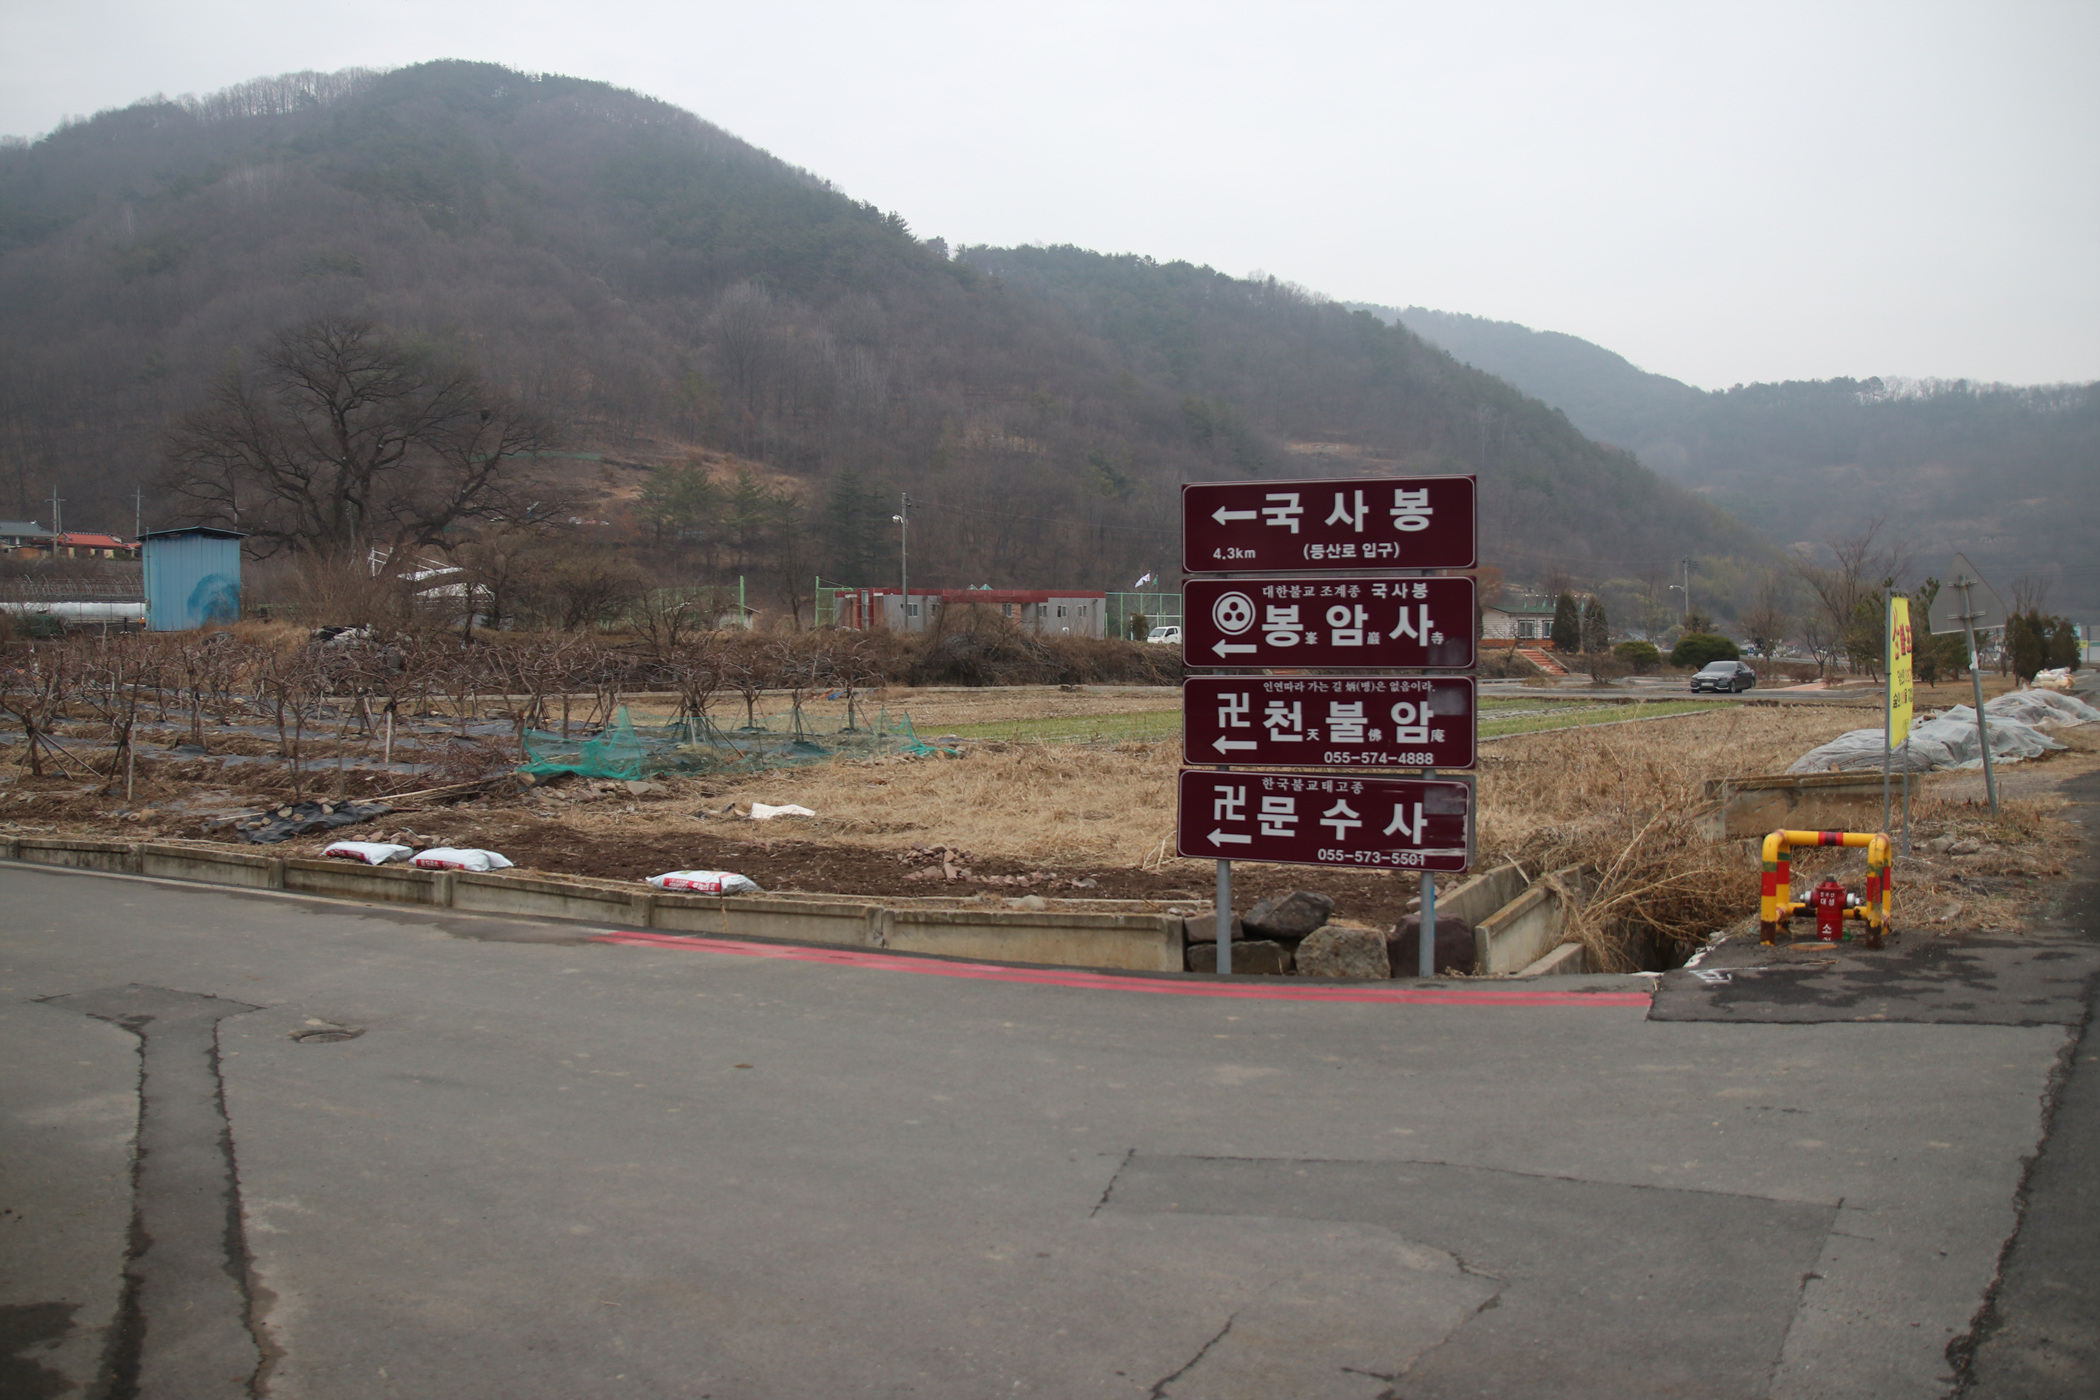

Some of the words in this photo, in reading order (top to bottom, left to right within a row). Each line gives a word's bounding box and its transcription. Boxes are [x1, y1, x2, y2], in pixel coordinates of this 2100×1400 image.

[1262, 488, 1433, 533] 국사봉
[1213, 548, 1255, 559] 4.3km
[1304, 544, 1356, 559] (등산로
[1363, 542, 1399, 558] 입구)
[1263, 585, 1315, 598] 대한불교
[1321, 585, 1360, 597] 조계종
[1372, 583, 1428, 598] 국사봉
[1264, 682, 1304, 692] 인연따라
[1309, 682, 1328, 691] 가는
[1333, 682, 1341, 691] 길
[1323, 752, 1433, 765] 055-574-4888
[1263, 777, 1364, 794] 한국불교태고종
[1257, 796, 1427, 844] 문수사
[1317, 849, 1426, 866] 055-573-5501
